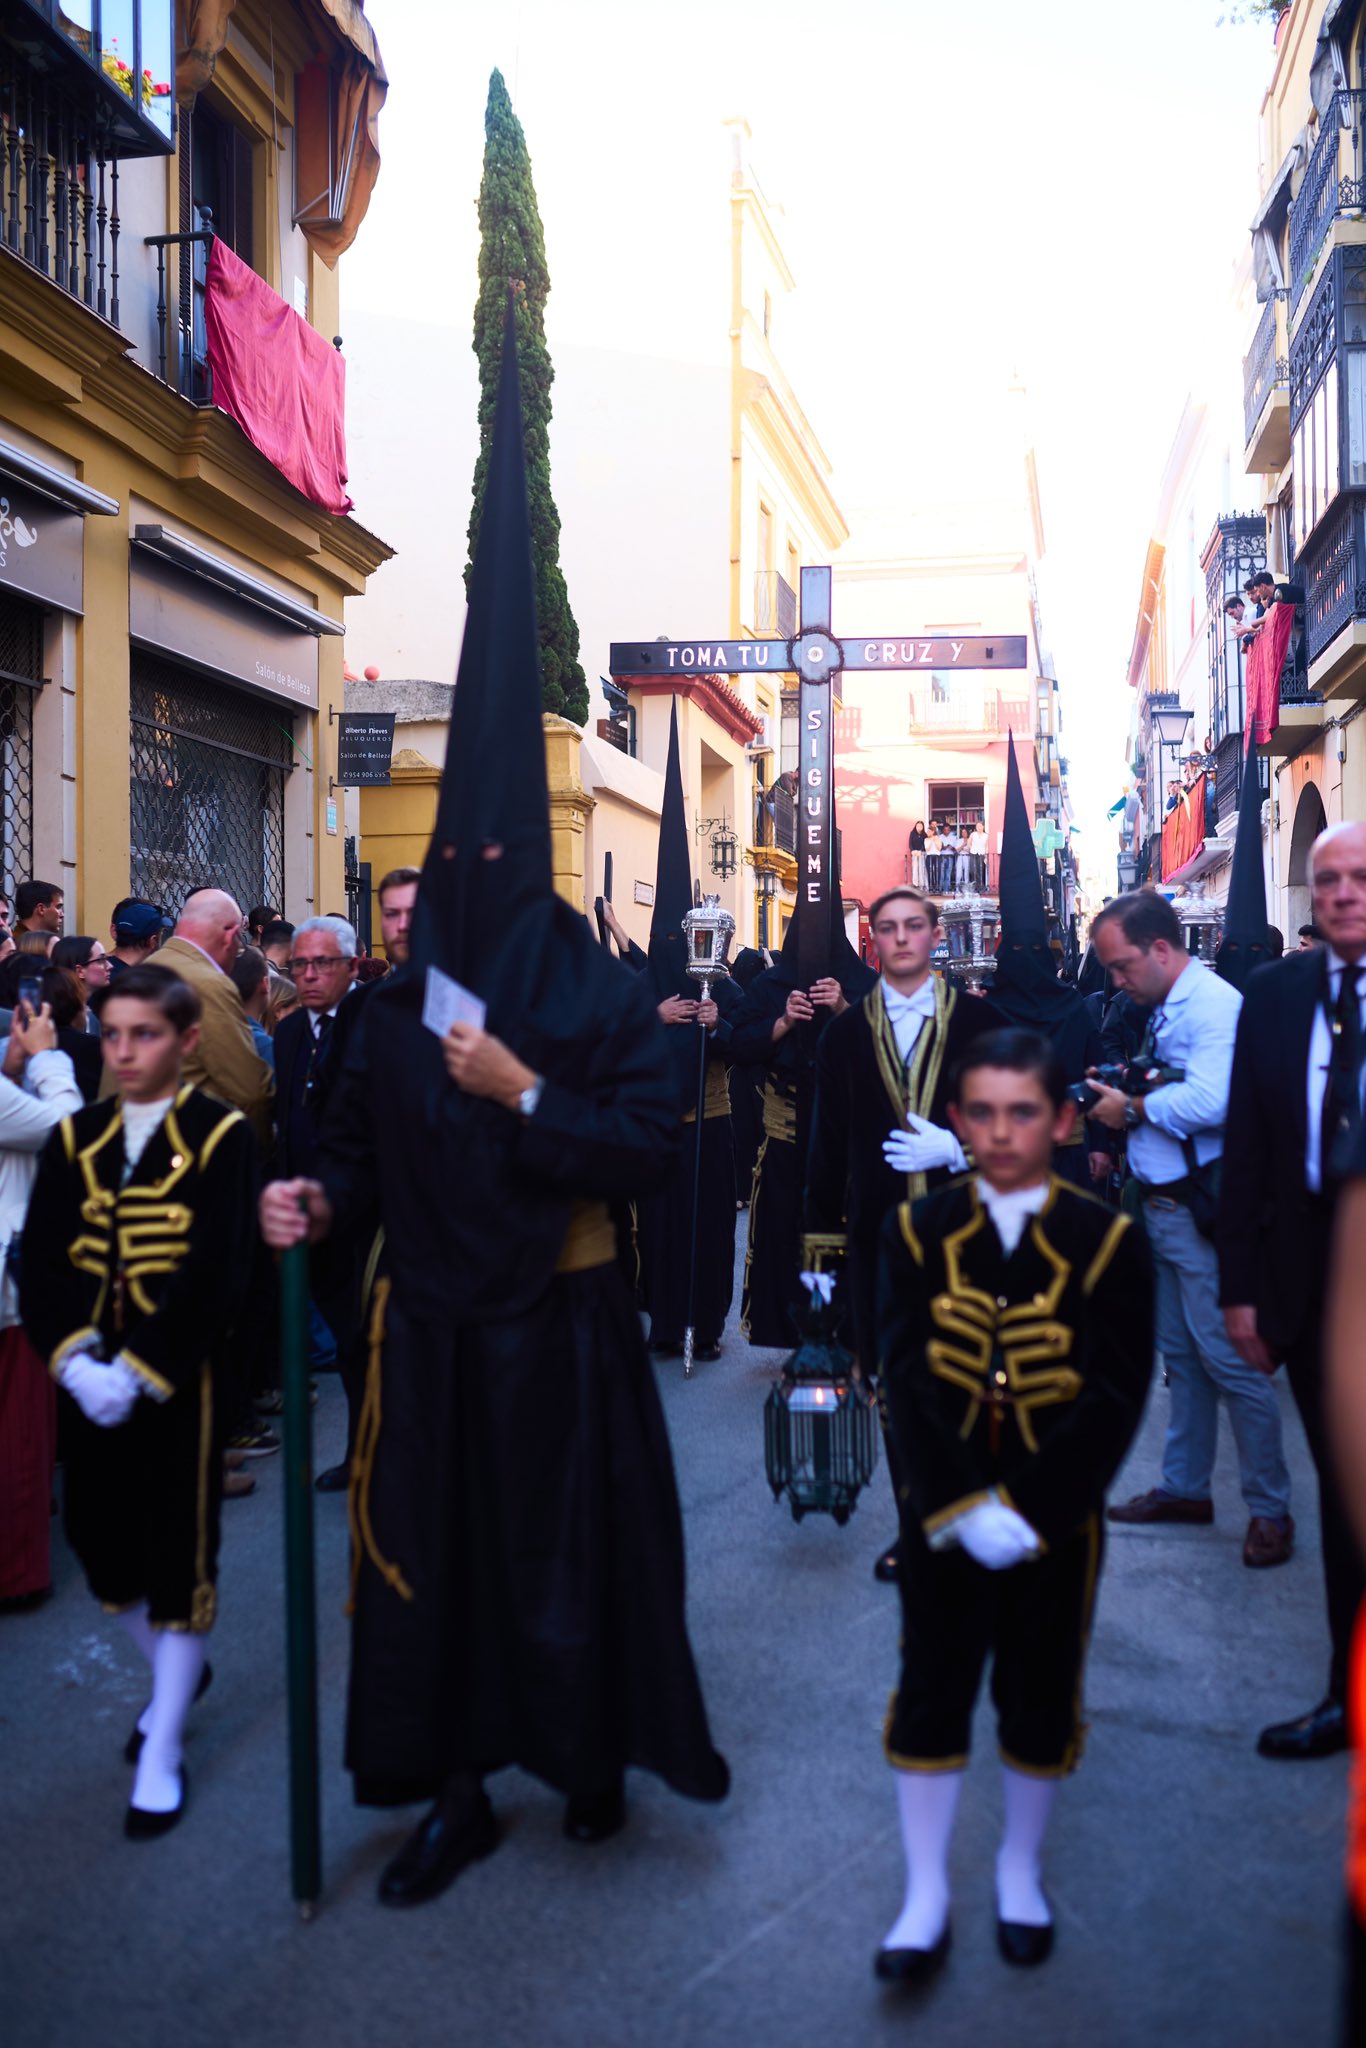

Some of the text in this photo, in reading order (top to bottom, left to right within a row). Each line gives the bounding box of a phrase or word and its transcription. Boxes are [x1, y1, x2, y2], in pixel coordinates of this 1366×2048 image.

[666, 642, 964, 667] TOMA TU CRUZ Y
[255, 661, 311, 695] Salón de Belleza
